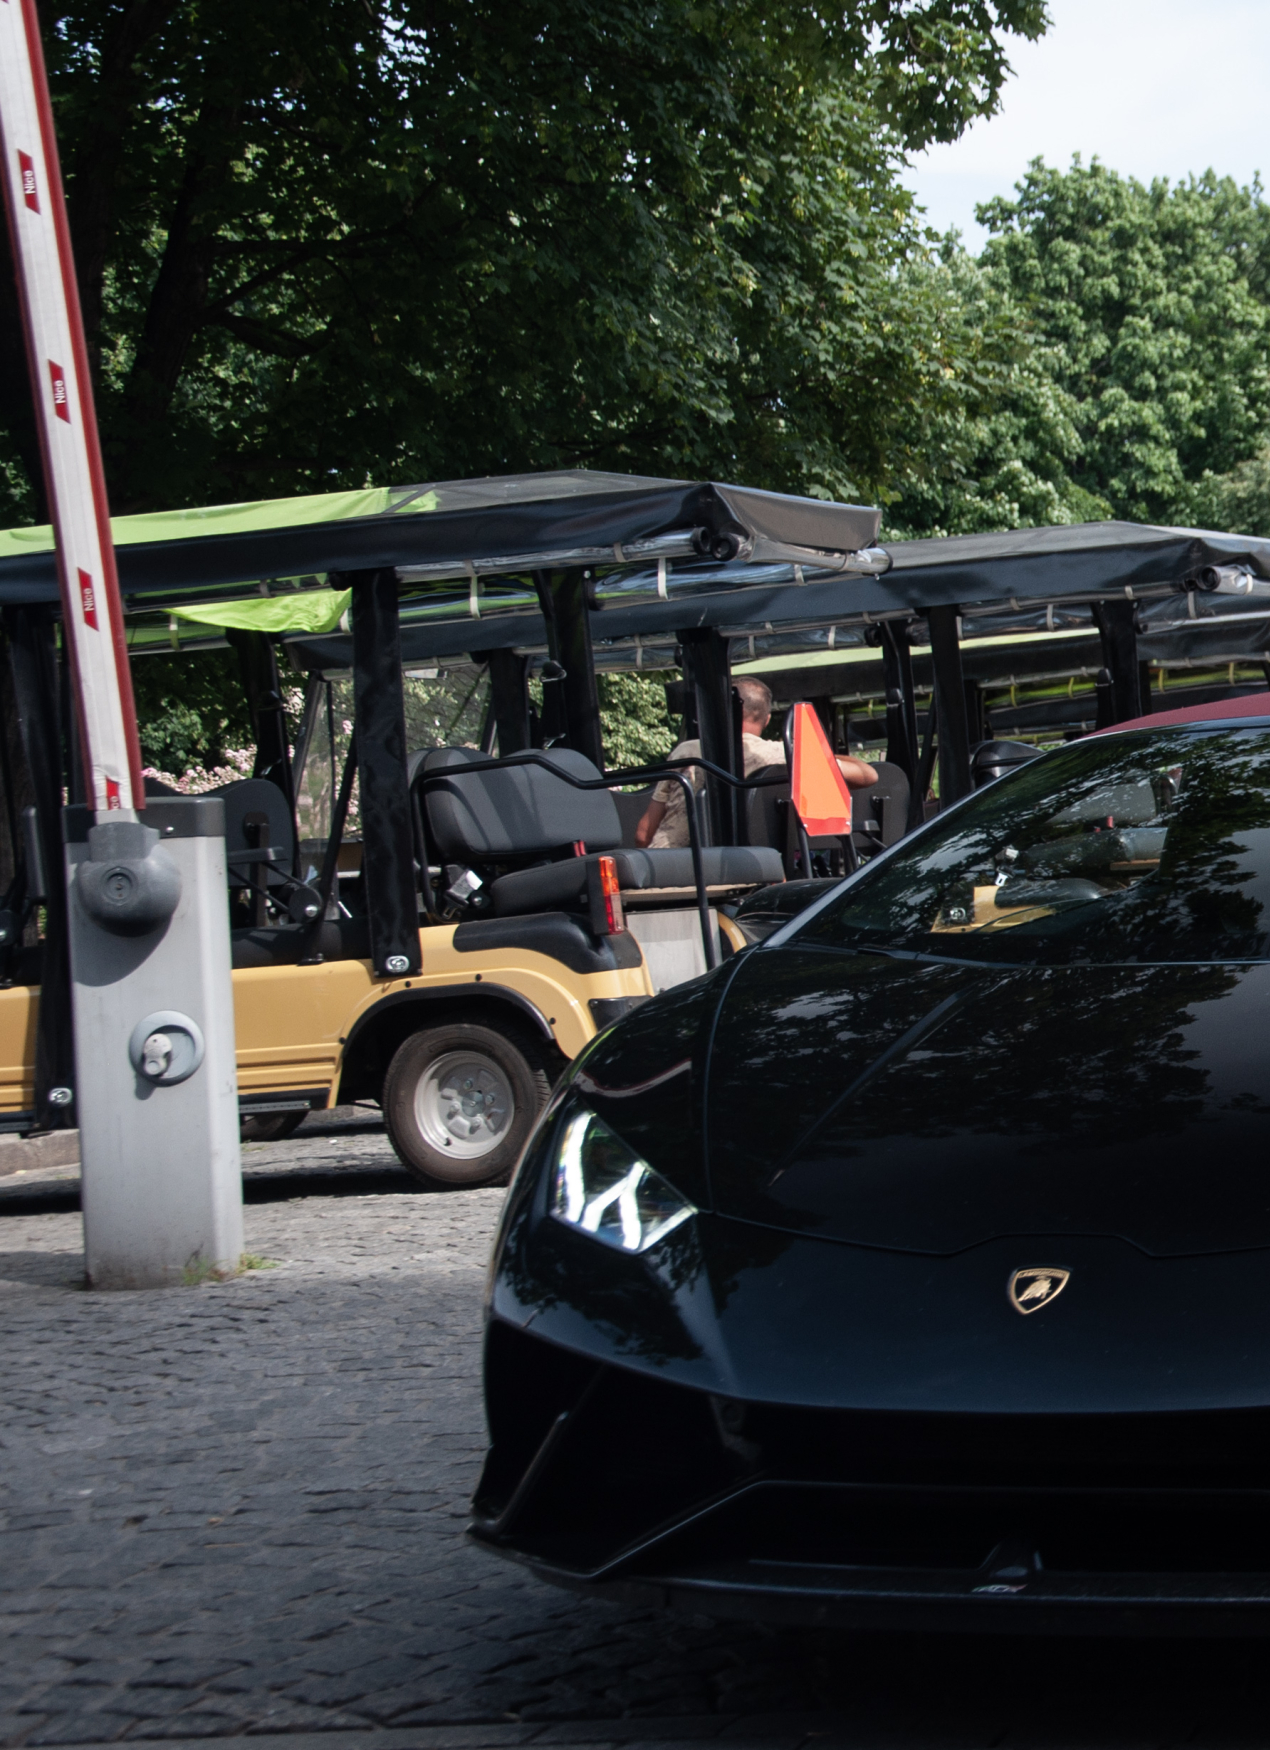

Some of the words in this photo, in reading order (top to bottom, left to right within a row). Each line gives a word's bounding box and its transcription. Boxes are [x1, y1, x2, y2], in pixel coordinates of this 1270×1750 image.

[23, 169, 36, 194] Nice
[53, 379, 66, 404] Nice
[83, 587, 95, 612] Nice
